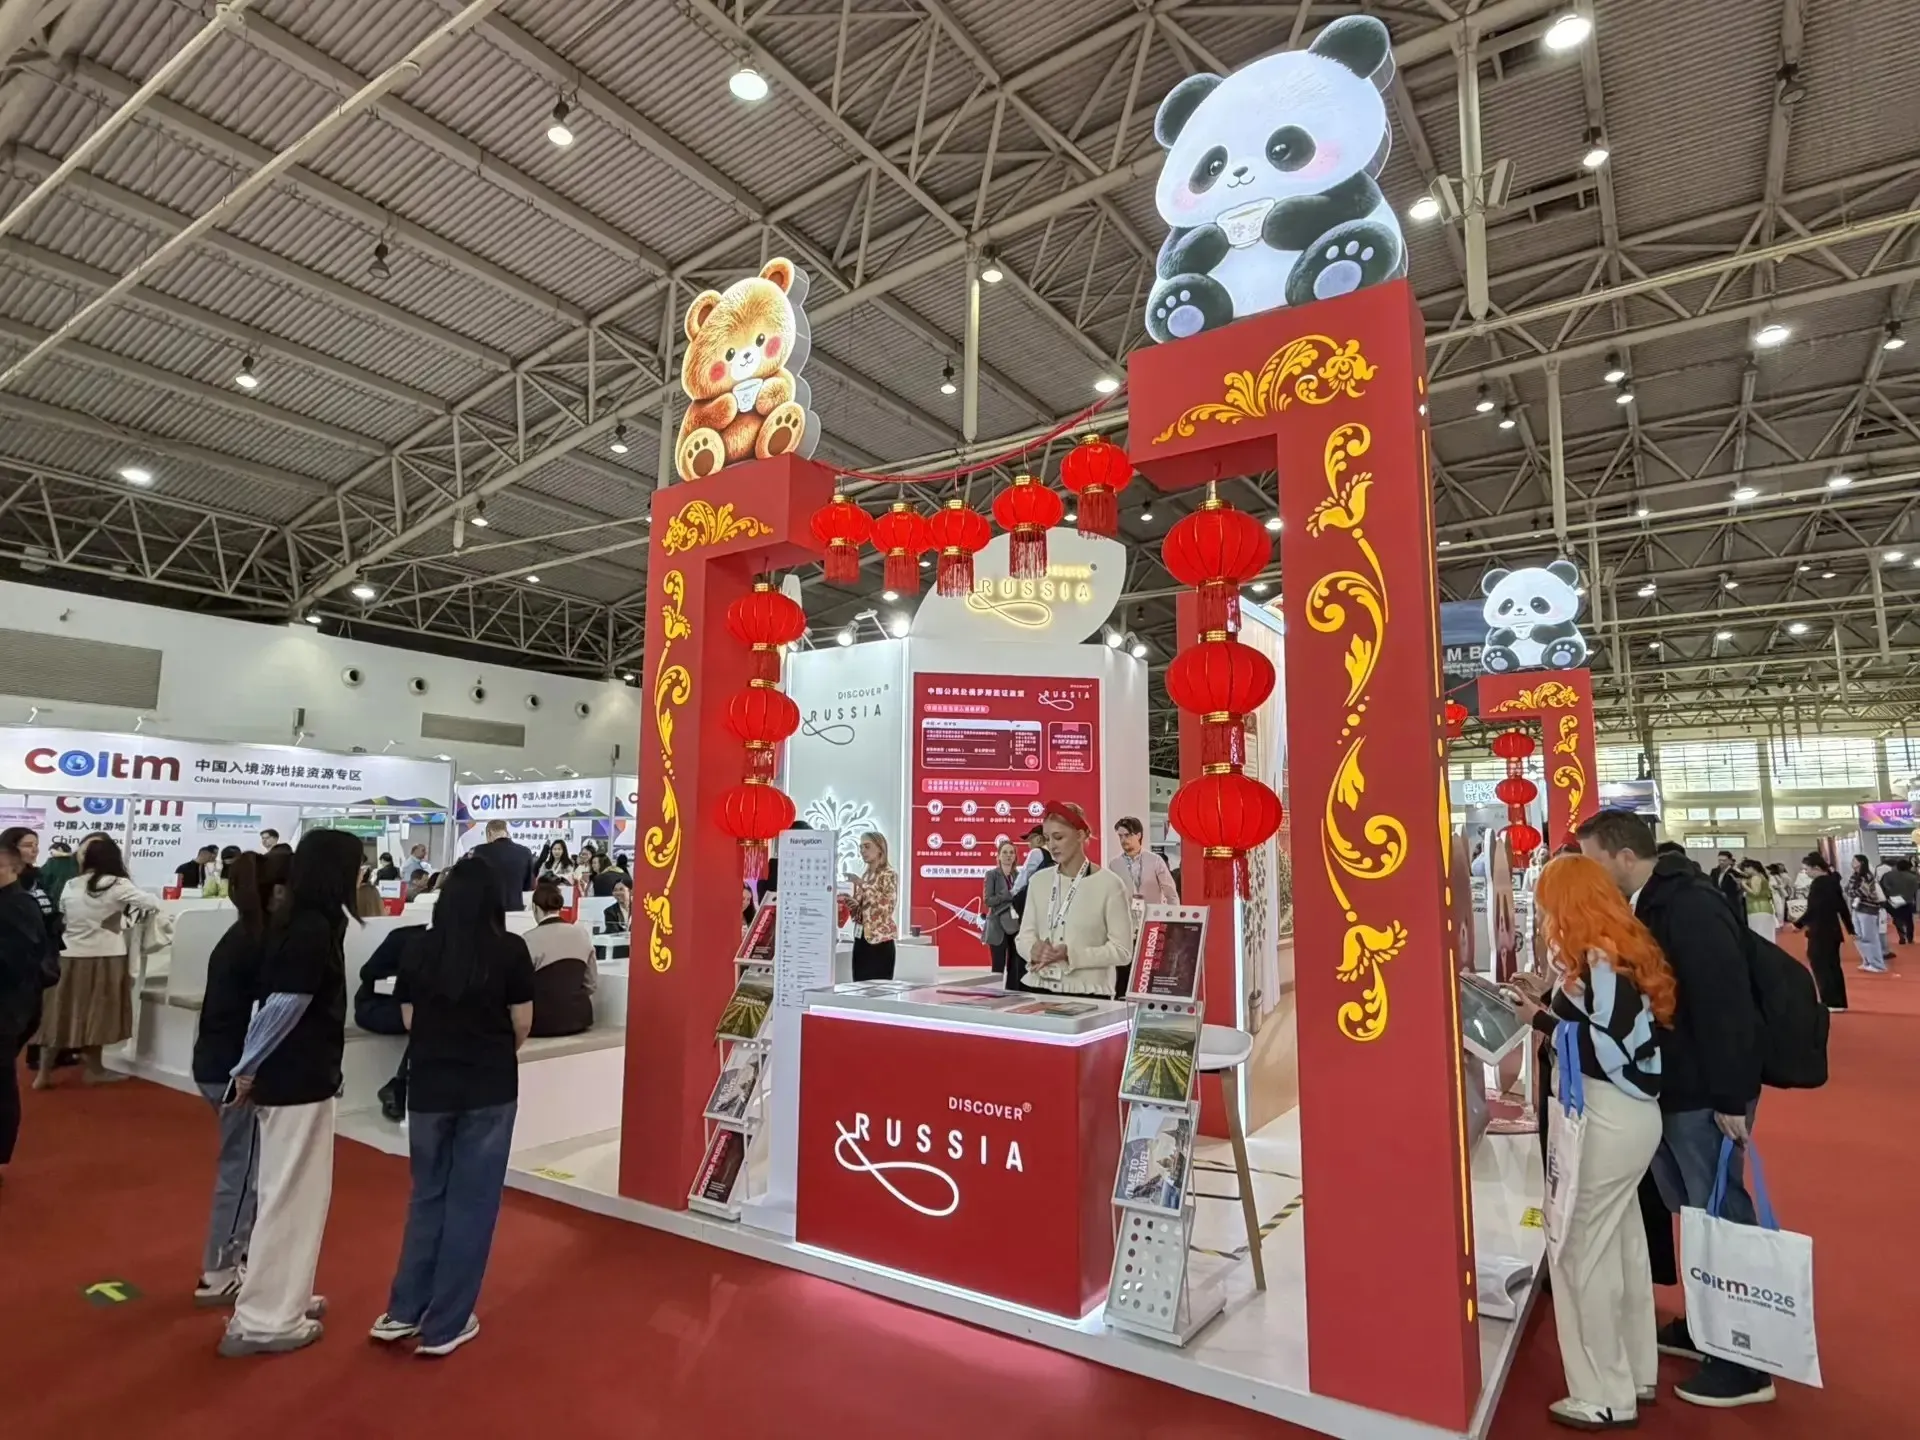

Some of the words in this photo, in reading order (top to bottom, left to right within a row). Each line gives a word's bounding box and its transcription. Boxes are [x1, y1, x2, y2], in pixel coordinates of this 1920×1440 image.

[195, 759, 362, 781] 中国入境游地接资源专区
[194, 775, 220, 785] China
[222, 777, 260, 786] Inbound
[262, 780, 288, 788] Travel
[289, 782, 330, 790] Resources
[51, 835, 81, 845] Chin
[146, 837, 181, 846] Travel
[790, 837, 822, 847] Navigation
[1145, 926, 1160, 957] RUSSIA
[1130, 1158, 1139, 1170] TO
[1136, 1147, 1151, 1183] TRAVEL
[1125, 1171, 1137, 1199] TIME
